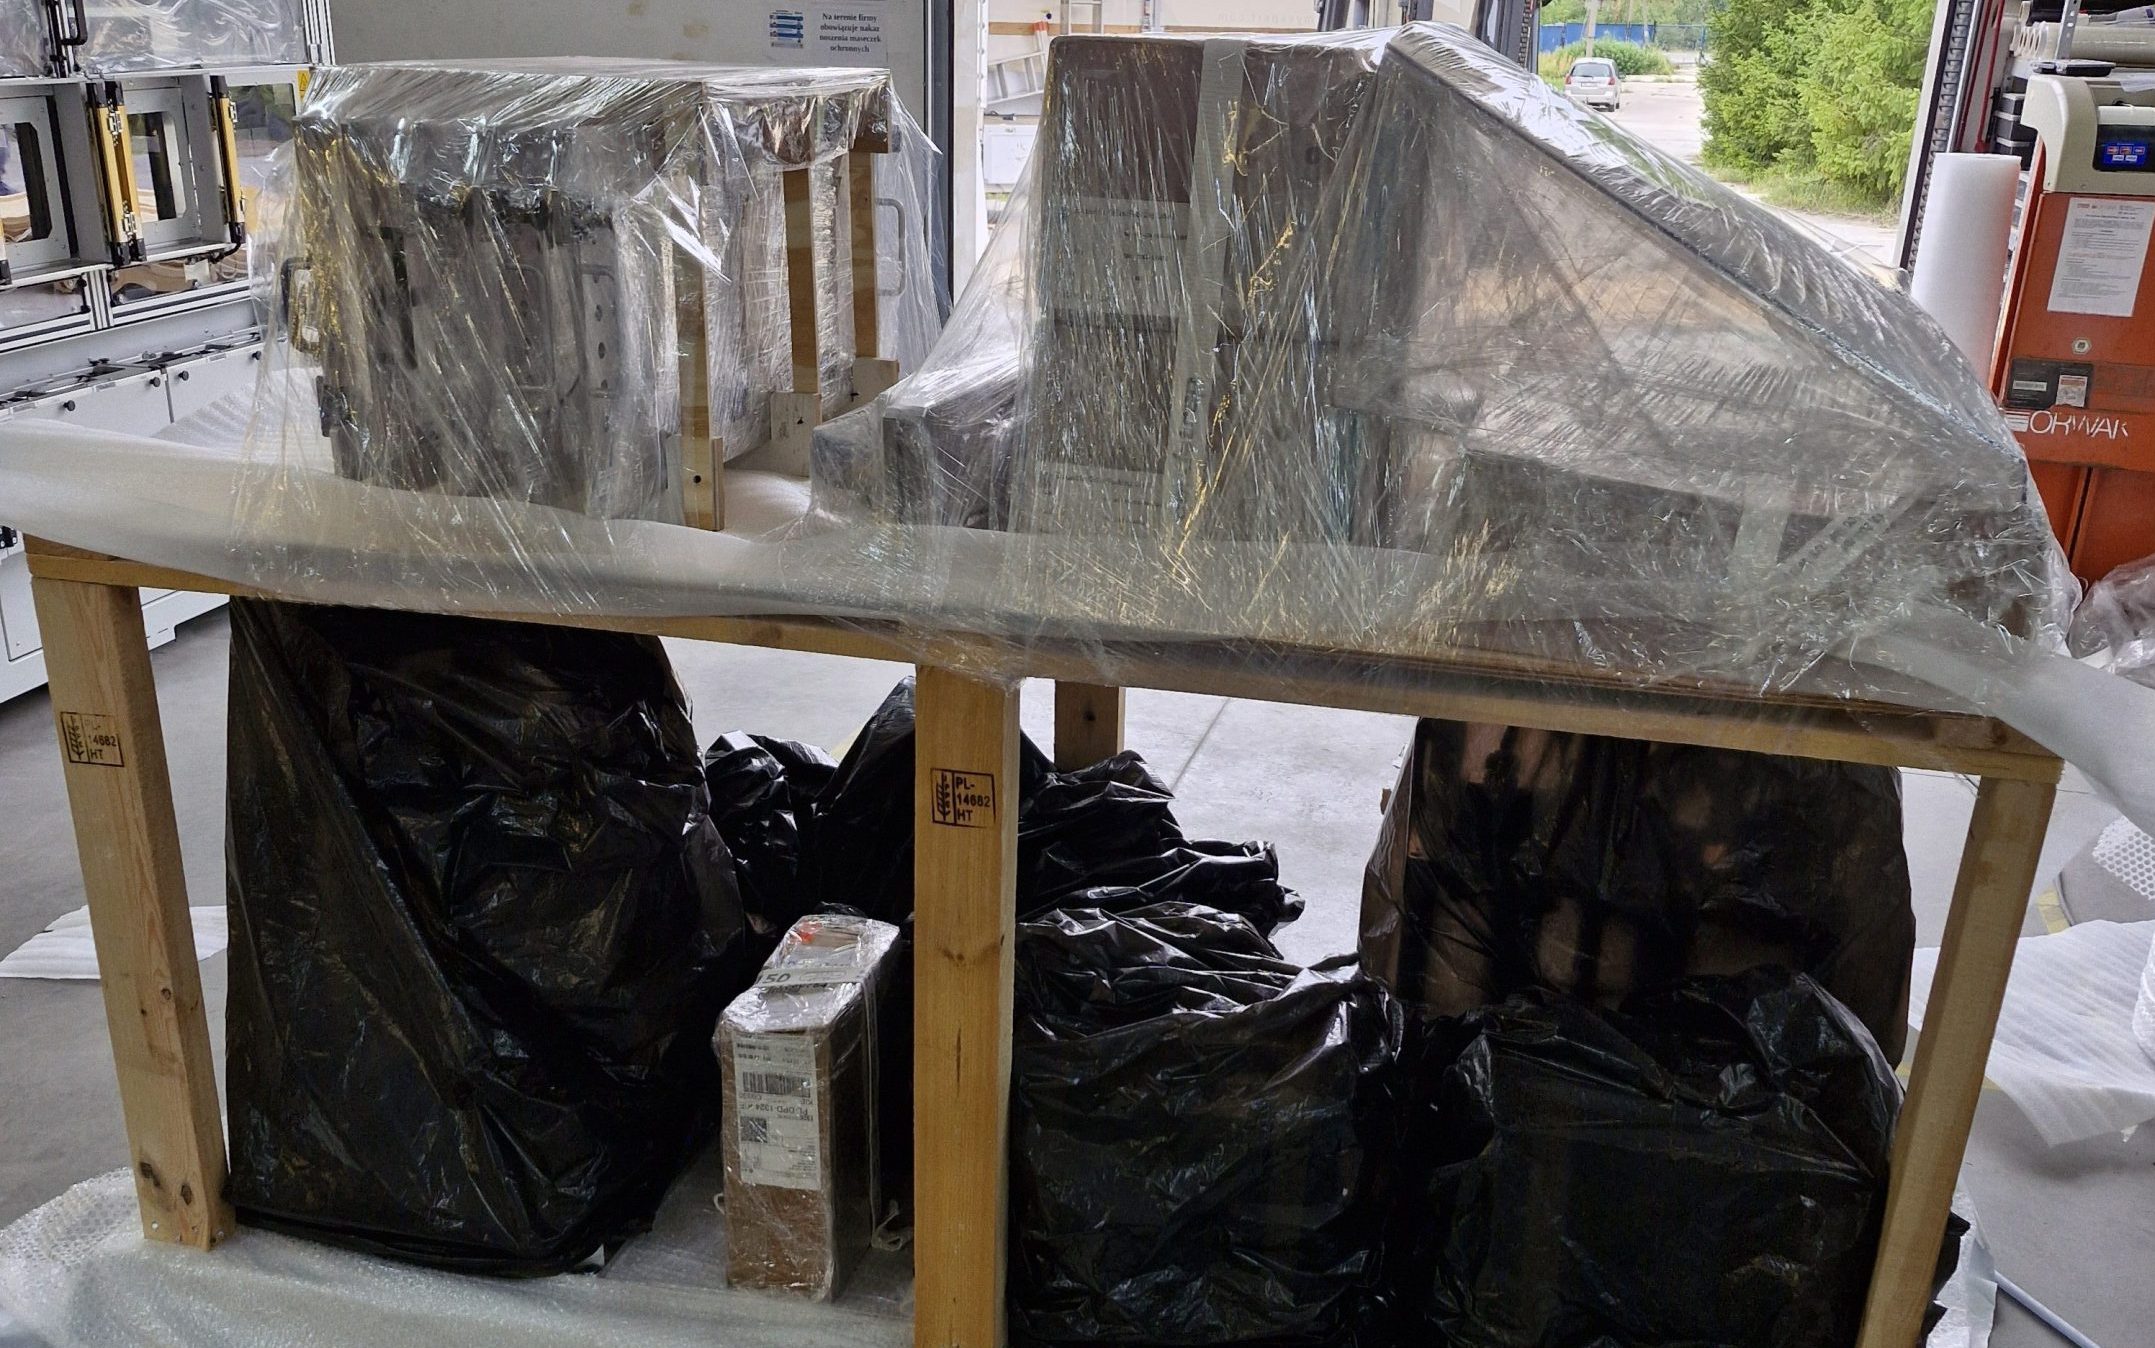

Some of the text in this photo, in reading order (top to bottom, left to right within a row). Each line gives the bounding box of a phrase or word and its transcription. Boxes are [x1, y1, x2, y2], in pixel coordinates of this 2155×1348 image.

[90, 749, 103, 759] HT
[956, 777, 975, 789] PL-
[957, 793, 990, 807] 14682
[957, 808, 973, 821] HT
